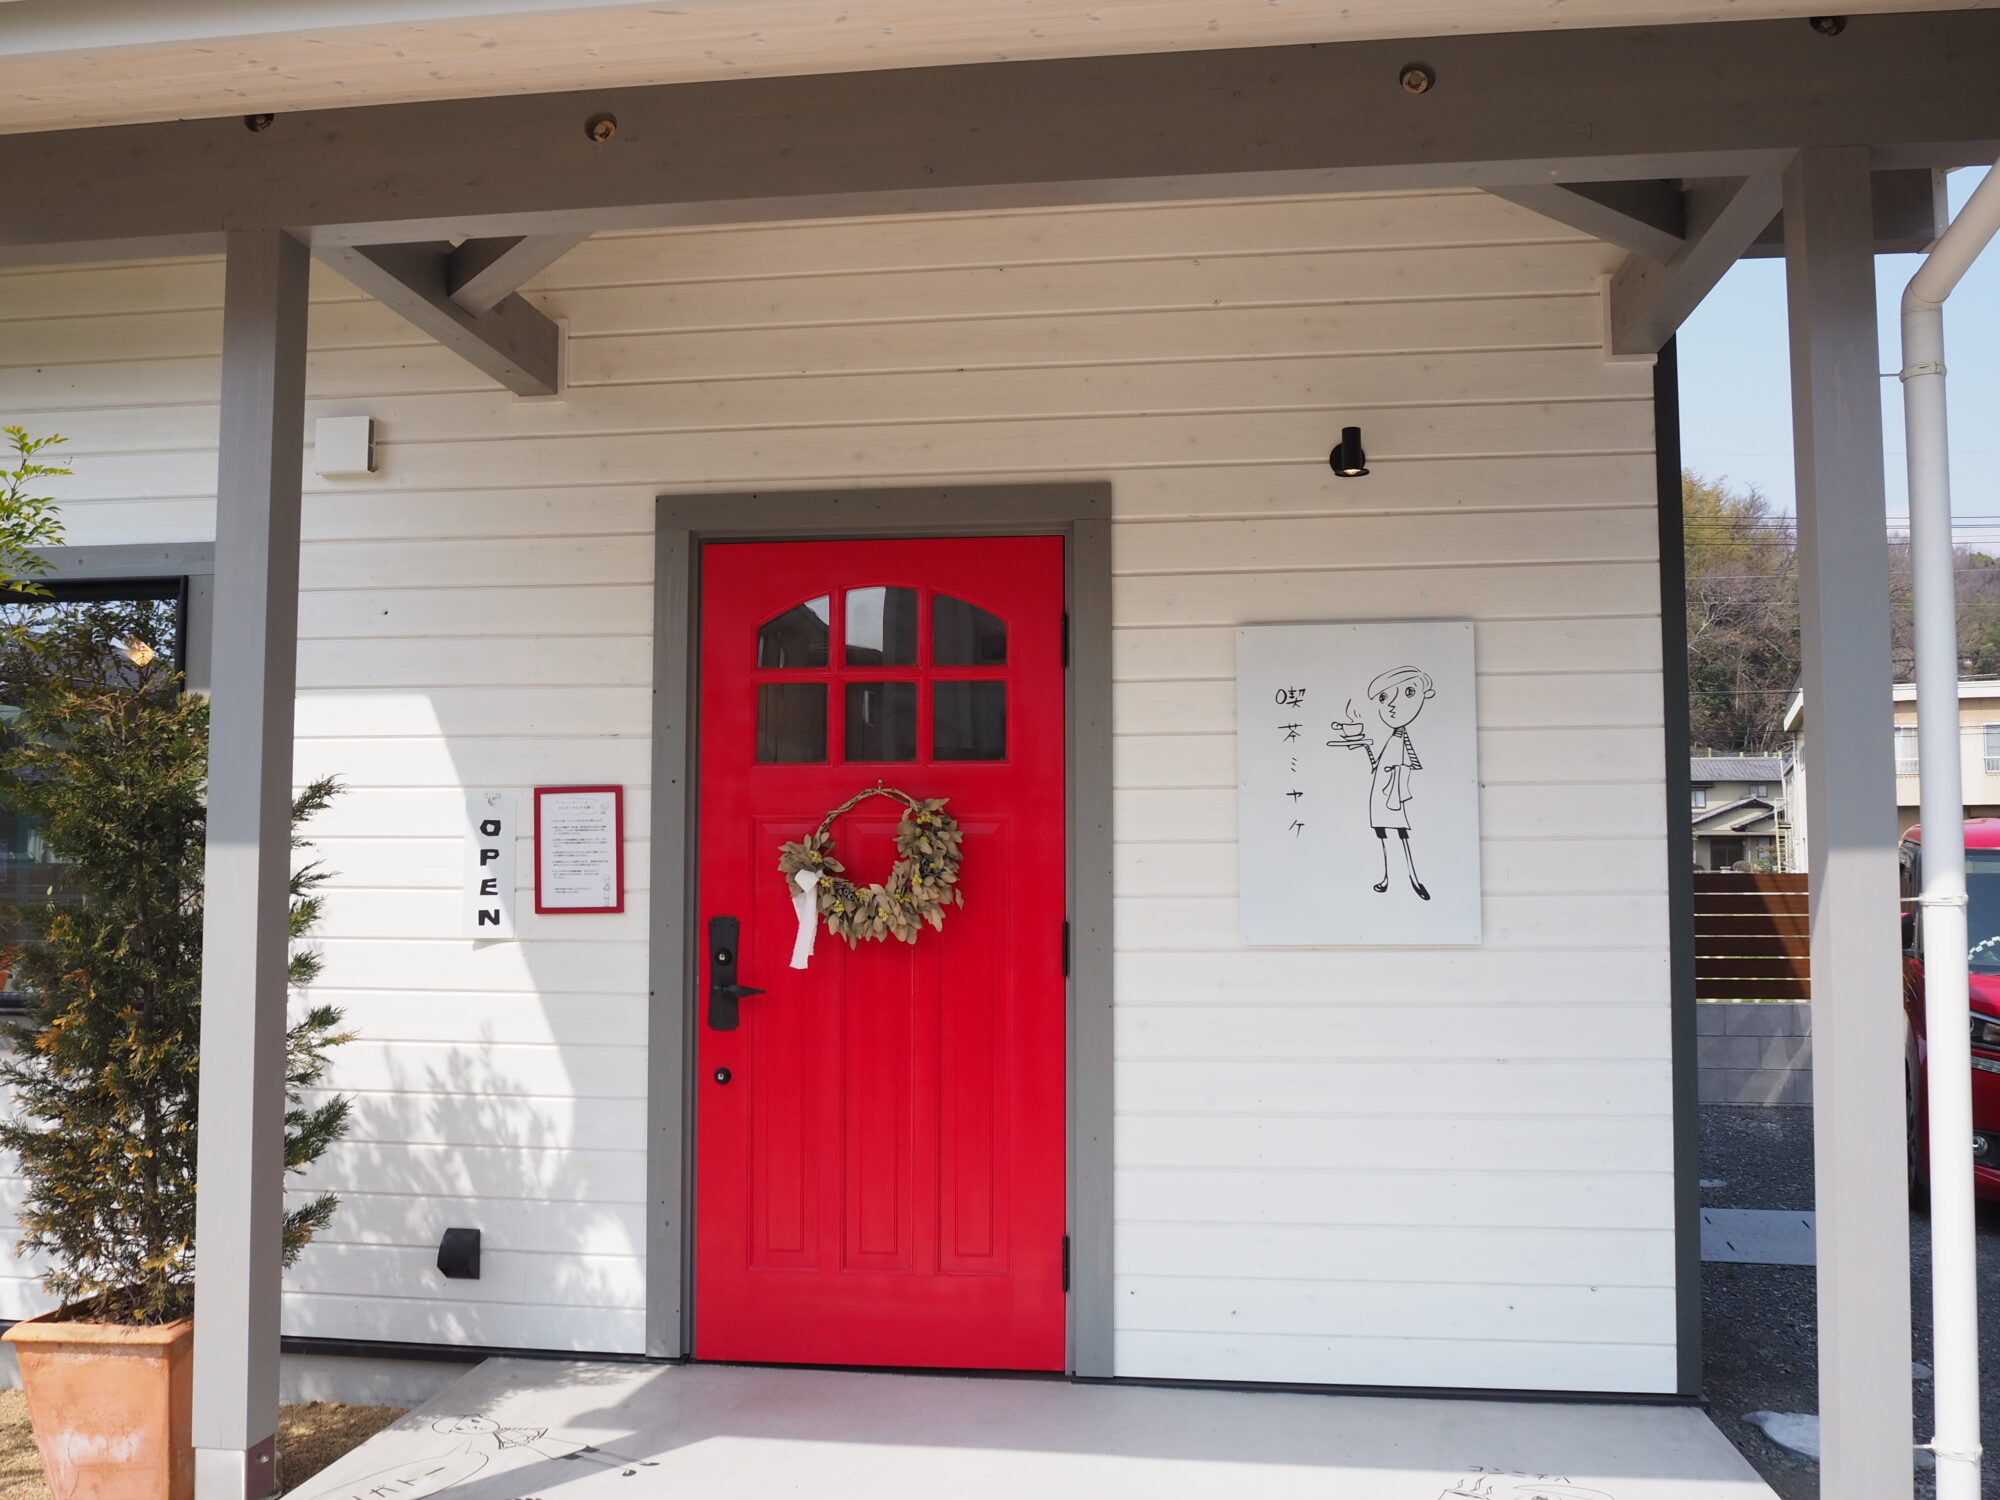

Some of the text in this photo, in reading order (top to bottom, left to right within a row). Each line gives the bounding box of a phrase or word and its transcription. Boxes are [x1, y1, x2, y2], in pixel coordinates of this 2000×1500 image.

[1275, 686, 1306, 838] 喫茶ミヤケ
[479, 819, 502, 926] OPEN
